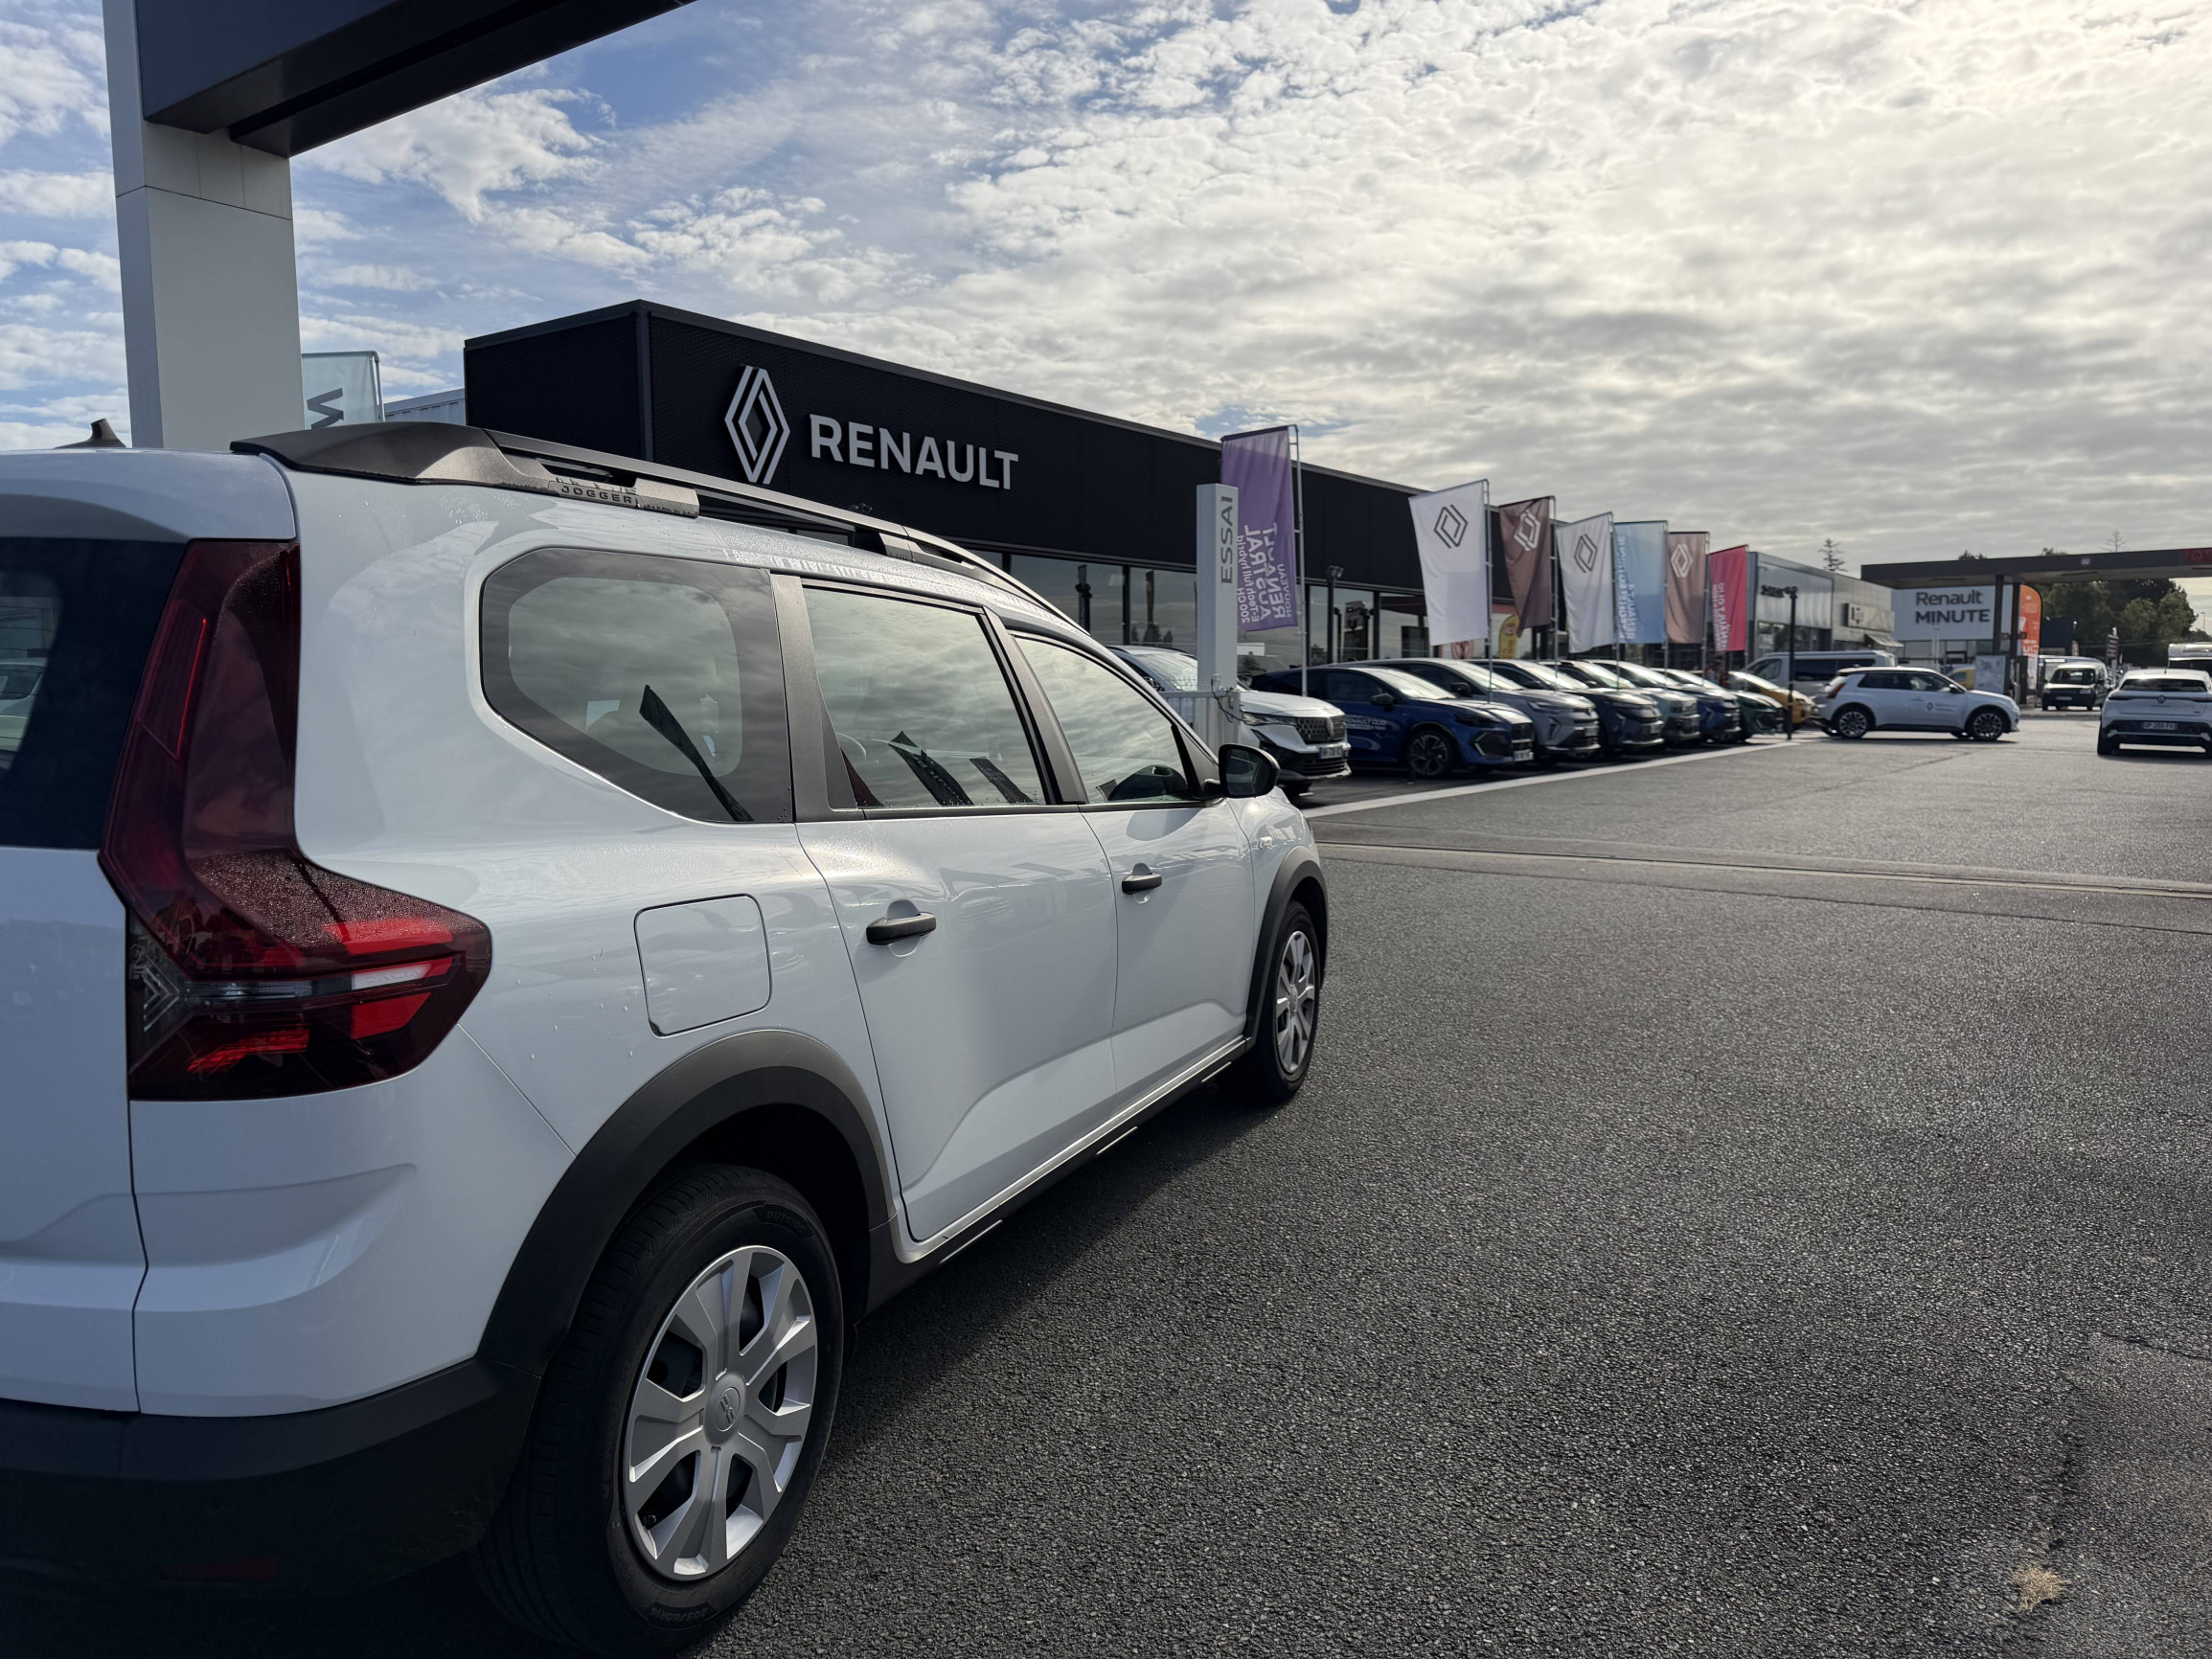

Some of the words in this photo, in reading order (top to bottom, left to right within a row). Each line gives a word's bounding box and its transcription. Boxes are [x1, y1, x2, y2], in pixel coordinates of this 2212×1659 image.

[809, 413, 1019, 490] RENAULT
[561, 485, 632, 504] JOGGER
[1220, 495, 1233, 584] ESSAI
[1916, 589, 1983, 605] Renault
[1915, 608, 1991, 625] MINUTE
